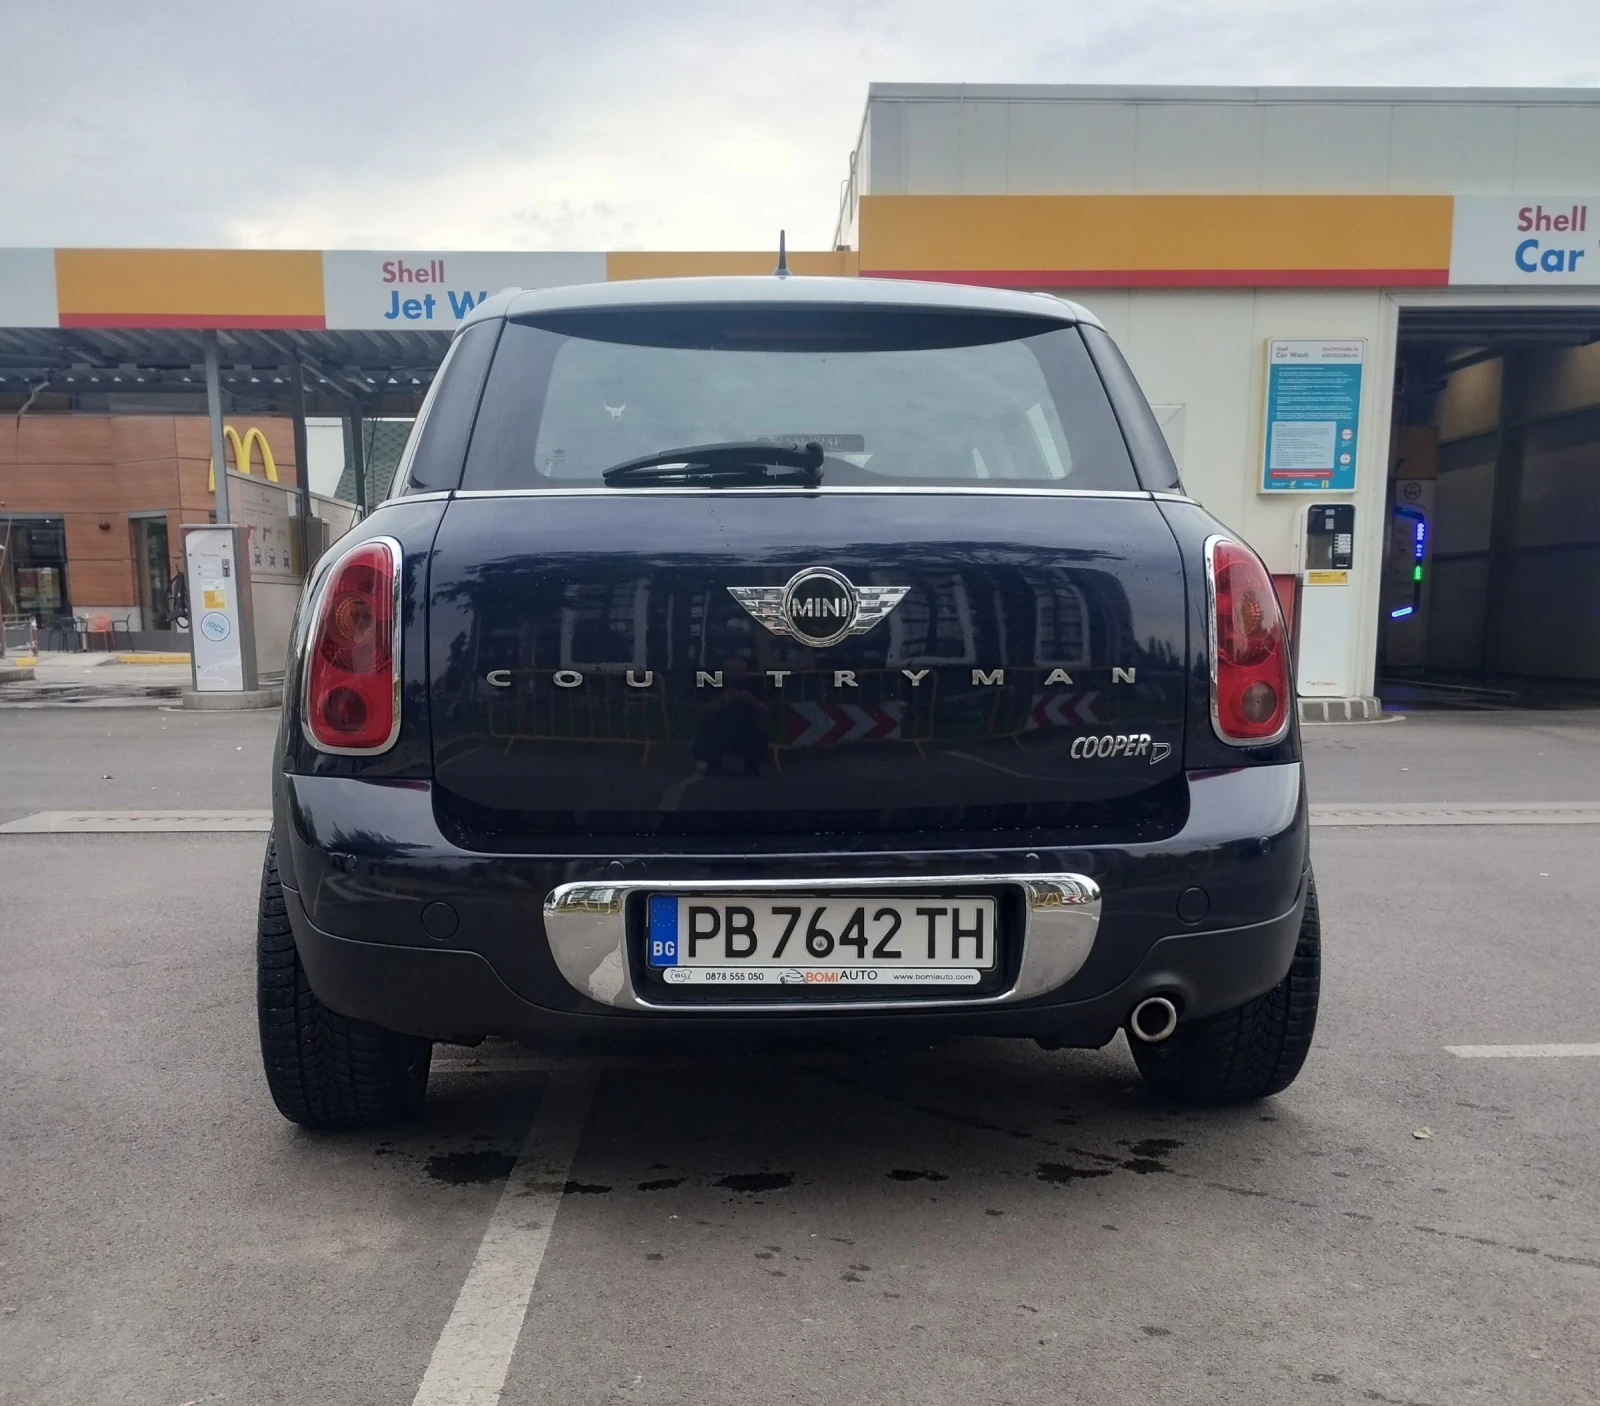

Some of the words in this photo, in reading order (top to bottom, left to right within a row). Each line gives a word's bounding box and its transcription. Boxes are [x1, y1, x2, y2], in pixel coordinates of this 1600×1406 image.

[1517, 205, 1587, 232] Shell
[1515, 238, 1585, 273] Car
[382, 260, 445, 283] Shell
[384, 290, 436, 320] Jet
[792, 597, 847, 617] MINI
[486, 667, 1136, 688] COUNTRYMAN
[1070, 733, 1152, 760] COOPER
[1149, 742, 1172, 765] D
[688, 906, 758, 959] PB
[771, 906, 902, 959] 7642
[916, 907, 984, 959] TH
[653, 941, 675, 956] BG
[705, 972, 727, 981] 0878
[729, 972, 746, 981] 555
[747, 972, 764, 981] 050
[893, 972, 974, 981] www.bomiauto.com
